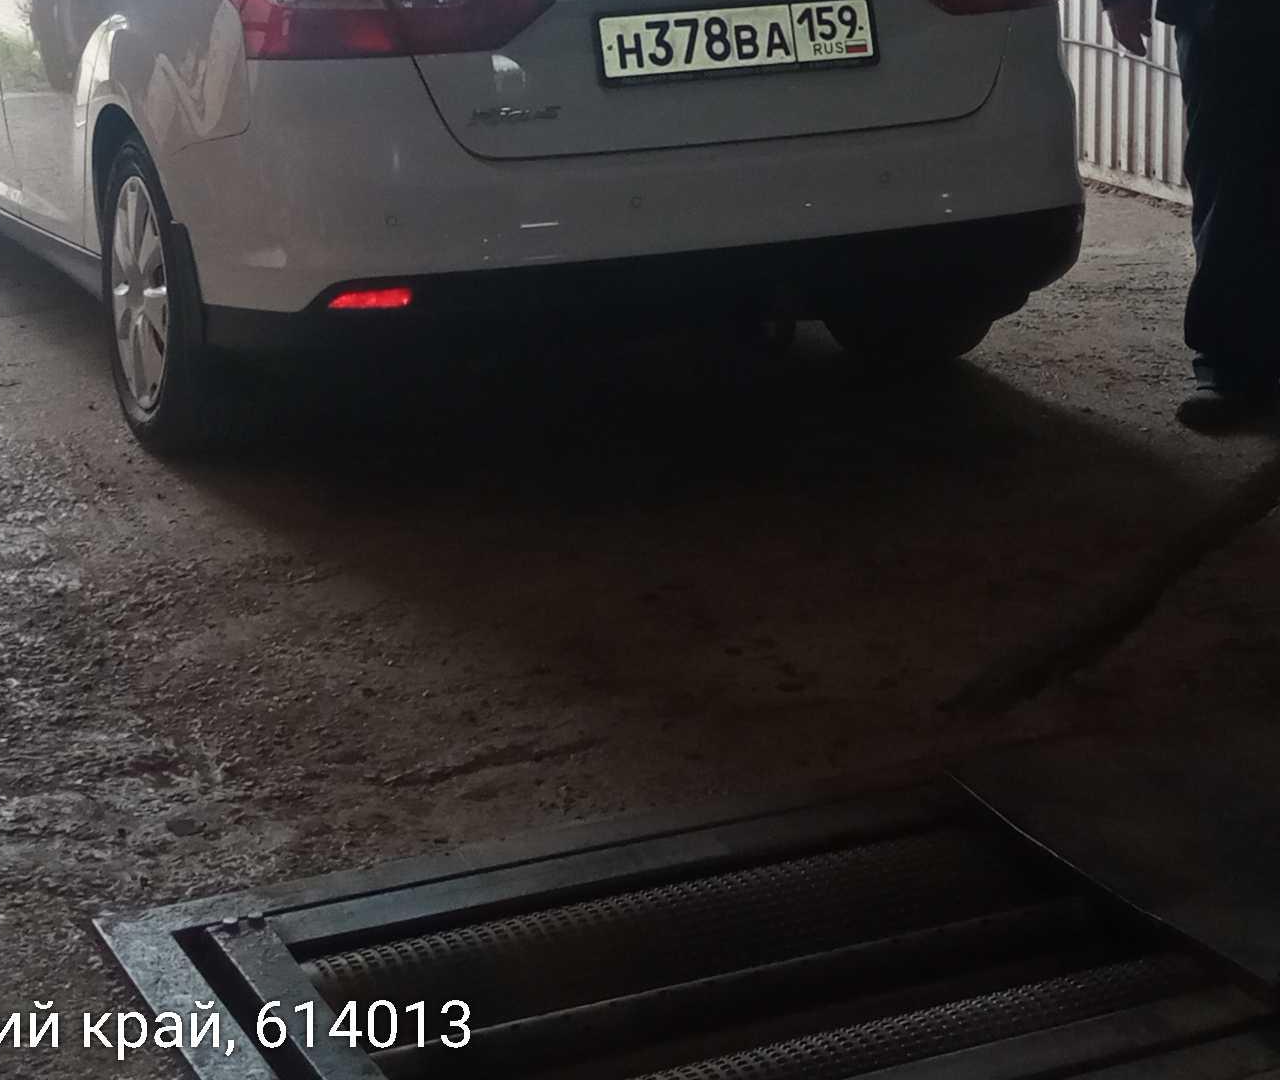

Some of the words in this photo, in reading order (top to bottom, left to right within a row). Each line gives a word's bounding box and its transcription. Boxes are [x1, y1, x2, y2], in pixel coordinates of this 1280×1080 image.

[617, 16, 791, 69] Н378ВА
[797, 5, 858, 42] 159
[813, 41, 844, 56] RUS
